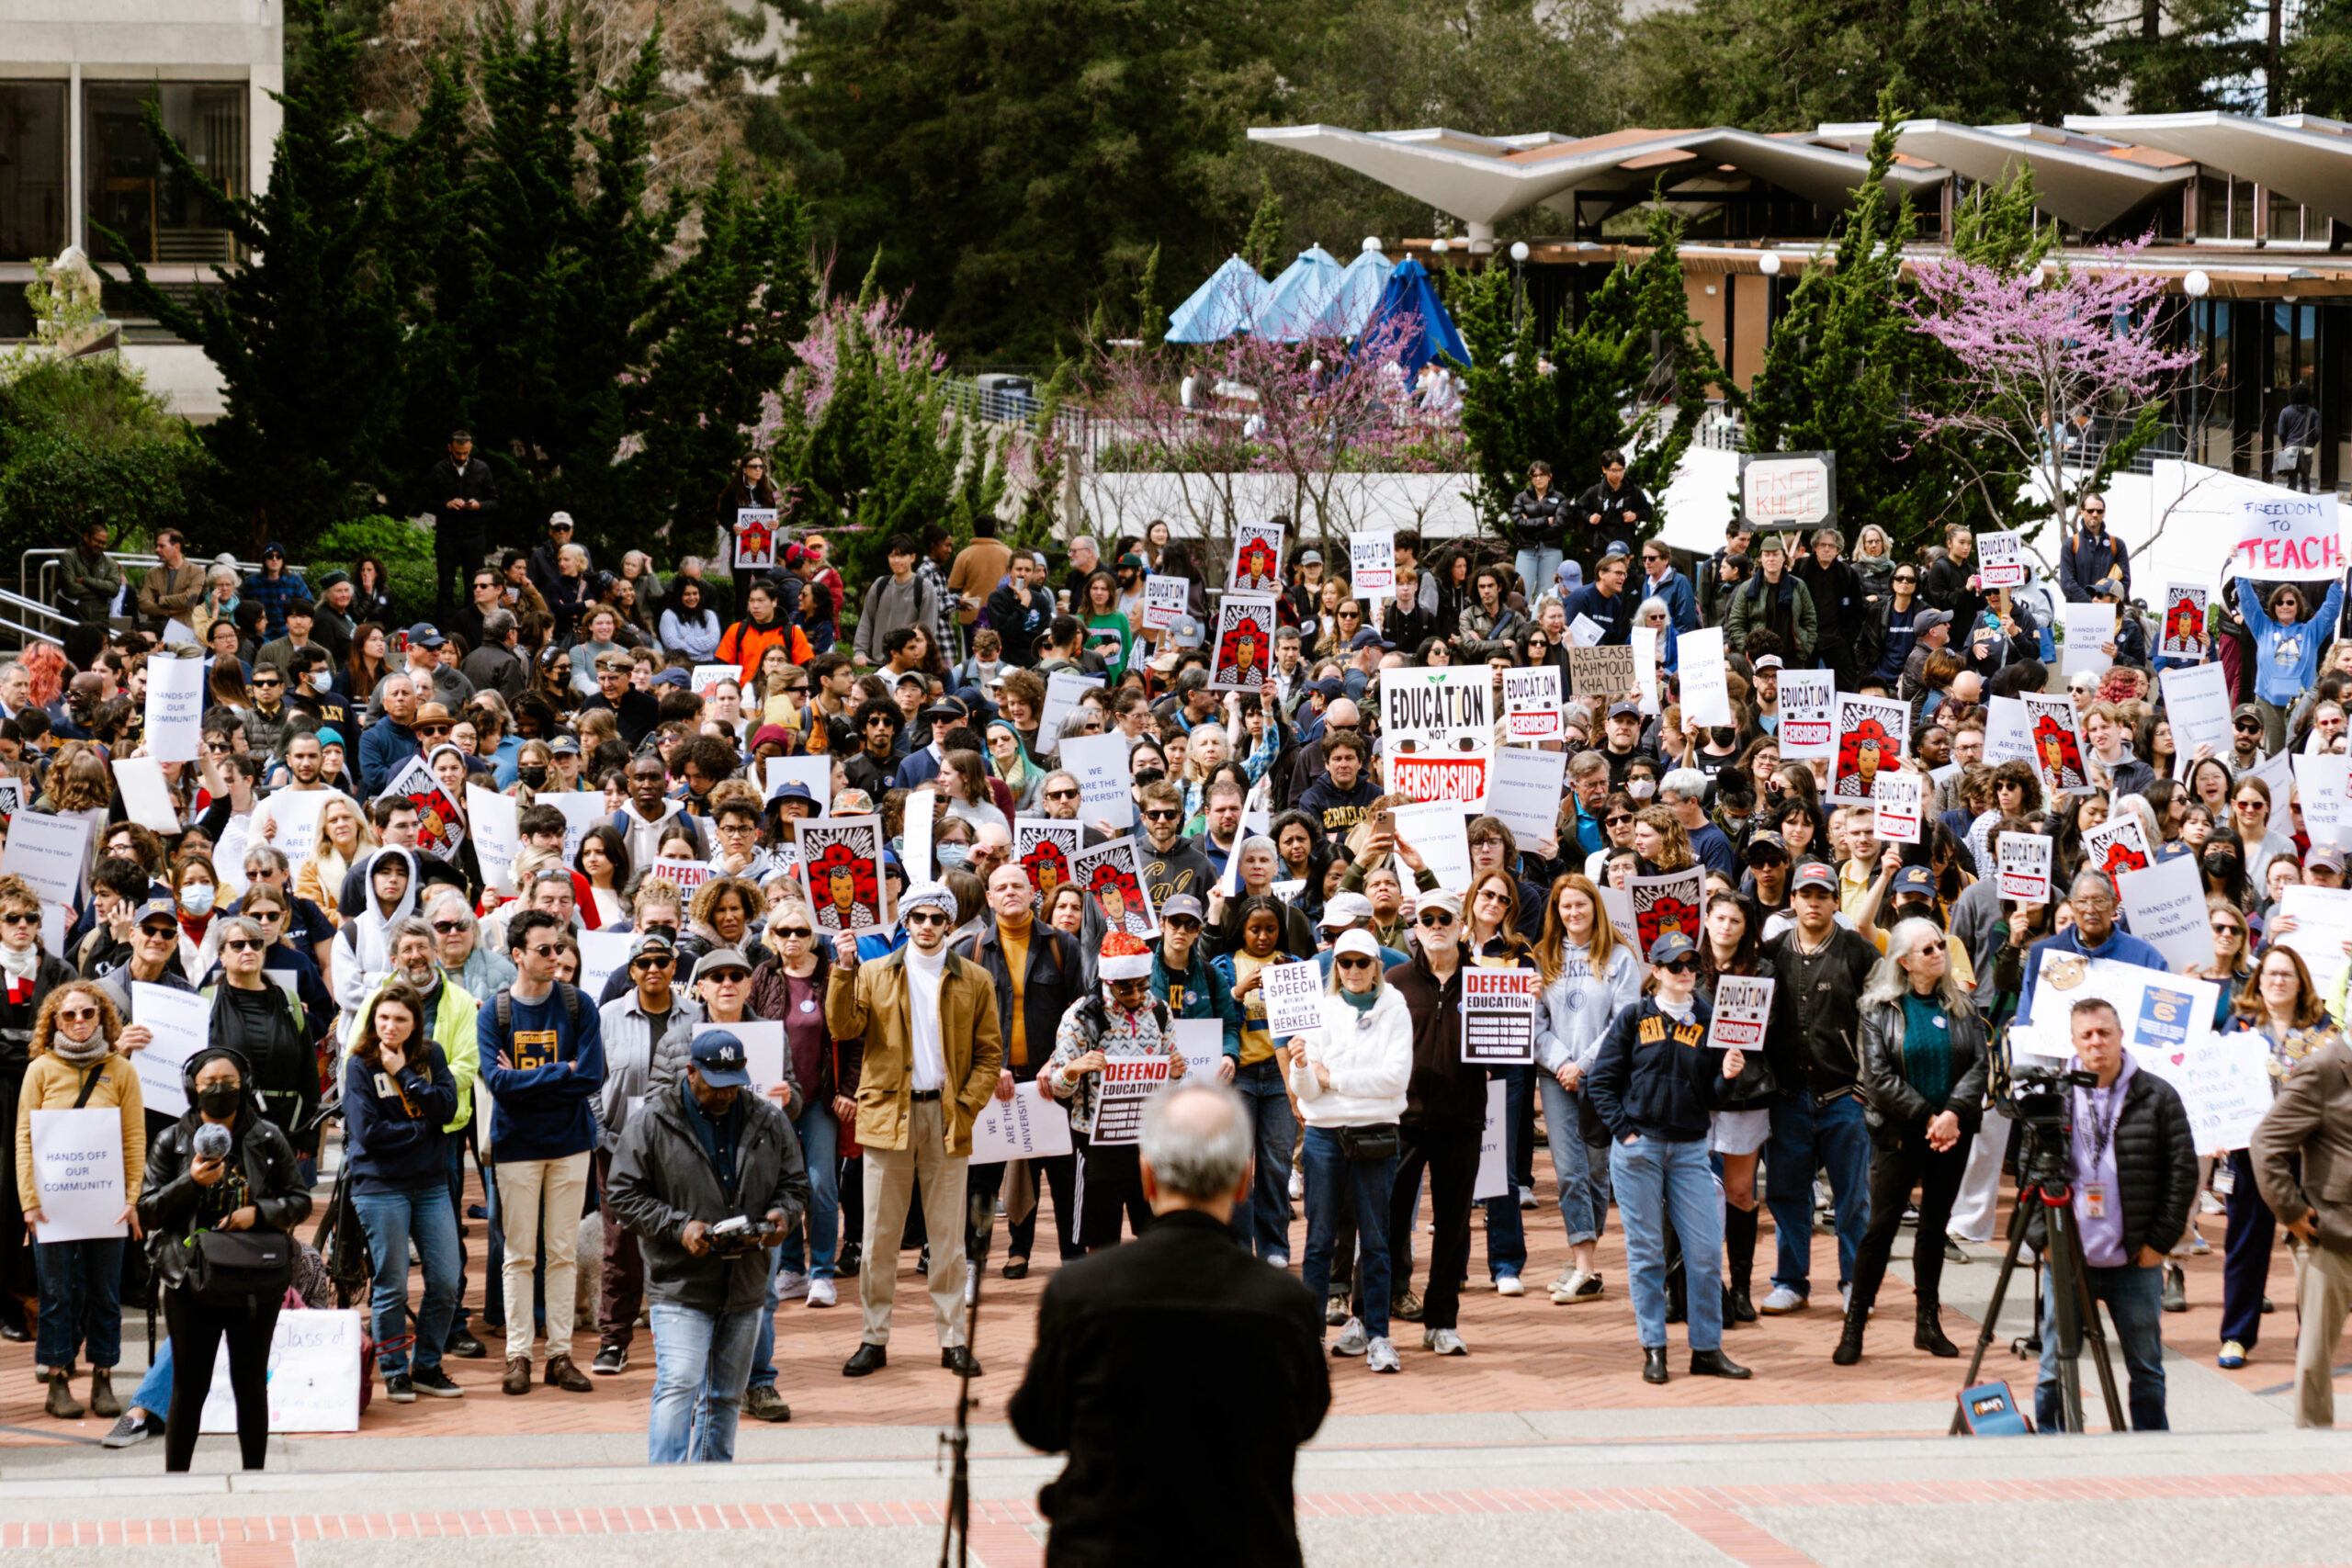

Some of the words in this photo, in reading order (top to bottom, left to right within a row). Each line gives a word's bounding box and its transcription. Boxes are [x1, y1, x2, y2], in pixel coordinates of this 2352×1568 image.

[2243, 501, 2323, 516] FREEDOM
[2267, 519, 2290, 532] TO
[1353, 543, 1391, 561] EDUCATION
[1980, 538, 2018, 558] EDUCATION
[2237, 534, 2342, 570] TEACH
[1148, 581, 1185, 600] EDUCATION
[1574, 646, 1634, 662] RELEASE
[2070, 642, 2101, 650] COMMUNI
[1572, 661, 1634, 677] MAHMOUD
[1508, 675, 1556, 700] EDUCATION
[1579, 677, 1634, 693] KHALIL
[154, 692, 184, 701] HANDS
[1781, 686, 1829, 708] EDUCATION
[166, 704, 186, 712] OUR
[1391, 683, 1486, 730] EDUCATION
[1511, 716, 1558, 734] CENSORSHIP
[1429, 729, 1448, 740] NOT
[1785, 724, 1830, 743] CENSORSHIP
[2010, 730, 2025, 739] WE
[1997, 740, 2015, 751] ARE
[2016, 743, 2035, 752] THE
[1504, 753, 1531, 761] FREEDOM
[1088, 767, 1102, 776] WE
[1098, 779, 1117, 791] THE
[1394, 766, 1482, 804] CENSORSHIP
[1499, 779, 1526, 787] FREEDOM
[1081, 790, 1125, 804] NIVERSITY
[1494, 808, 1521, 818] FREEDOM
[21, 817, 50, 827] FREEDOM
[58, 823, 78, 831] SPEAK
[297, 824, 312, 832] WE
[16, 841, 43, 852] FREEDOM
[52, 849, 74, 857] TEACH
[286, 839, 306, 847] ARE
[2002, 842, 2047, 863] EDUCATION
[655, 863, 707, 885] DEFEND
[2137, 902, 2175, 917] HANDS
[2173, 895, 2193, 908] OFF
[2158, 913, 2181, 925] OUR
[2142, 920, 2202, 942] COMMUNITY
[1274, 965, 1308, 983] FREE
[1270, 980, 1317, 998] SPEECH
[1467, 974, 1531, 994] DEFEND
[1467, 997, 1532, 1010] EDUCATION!
[1719, 987, 1770, 1009] EDUCATION
[1273, 1013, 1321, 1031] BERKELEY
[1469, 1017, 1499, 1026] FREEDOM
[1499, 1017, 1509, 1026] TO
[1510, 1017, 1530, 1026] SPEAK
[1469, 1026, 1499, 1035] FREEDOM
[1499, 1026, 1509, 1035] TO
[1510, 1026, 1530, 1035] TEACH
[1469, 1036, 1499, 1045] FREEDOM
[1499, 1036, 1509, 1045] TO
[1510, 1036, 1530, 1045] LEARN
[1476, 1046, 1488, 1055] FOR
[1192, 1056, 1211, 1066] OFF
[1104, 1062, 1168, 1082] DEFEND
[987, 1118, 997, 1135] WE
[1017, 1092, 1033, 1154] UNIVERSITY
[1001, 1122, 1016, 1145] ARE
[47, 1154, 85, 1166] HANDS
[85, 1150, 107, 1163] OFF
[65, 1168, 90, 1179] OUR
[44, 1180, 114, 1193] COMMUNITY
[274, 1321, 324, 1350] Class
[331, 1320, 345, 1347] of
